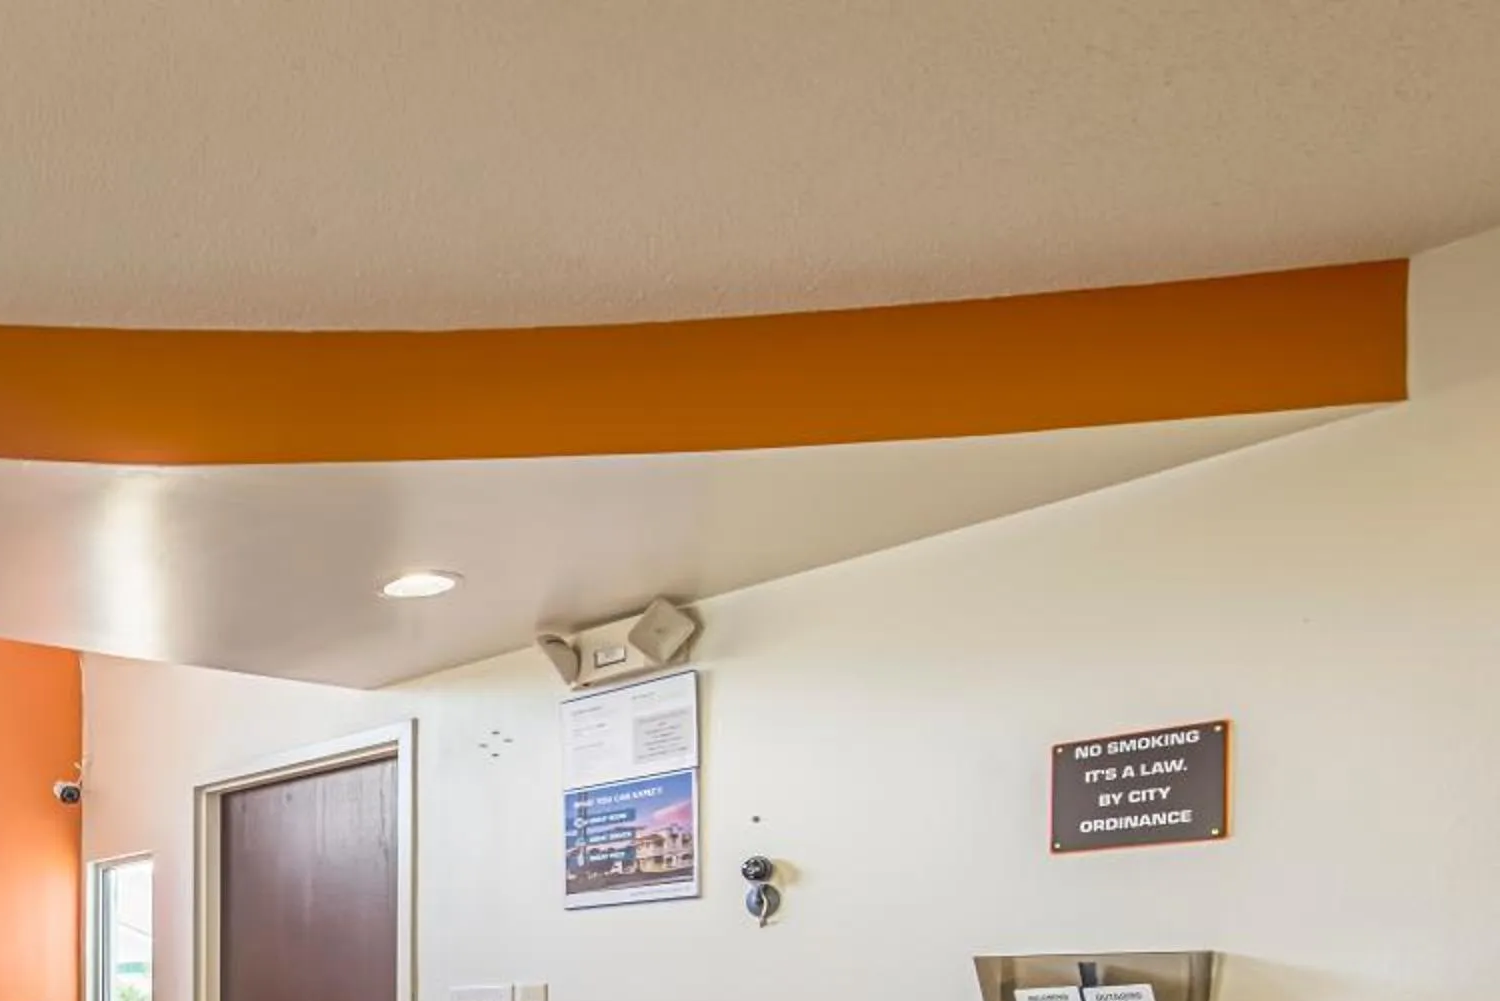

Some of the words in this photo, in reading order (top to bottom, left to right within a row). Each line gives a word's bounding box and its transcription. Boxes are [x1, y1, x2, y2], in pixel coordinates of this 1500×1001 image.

[1074, 743, 1103, 760] NO
[1107, 729, 1201, 756] SMOKING
[1084, 766, 1117, 784] IT'S
[1121, 764, 1135, 779] A
[1140, 758, 1188, 777] LAW.
[1098, 791, 1123, 807] BY
[1128, 786, 1171, 804] CITY
[1079, 809, 1193, 833] ORDINANCE
